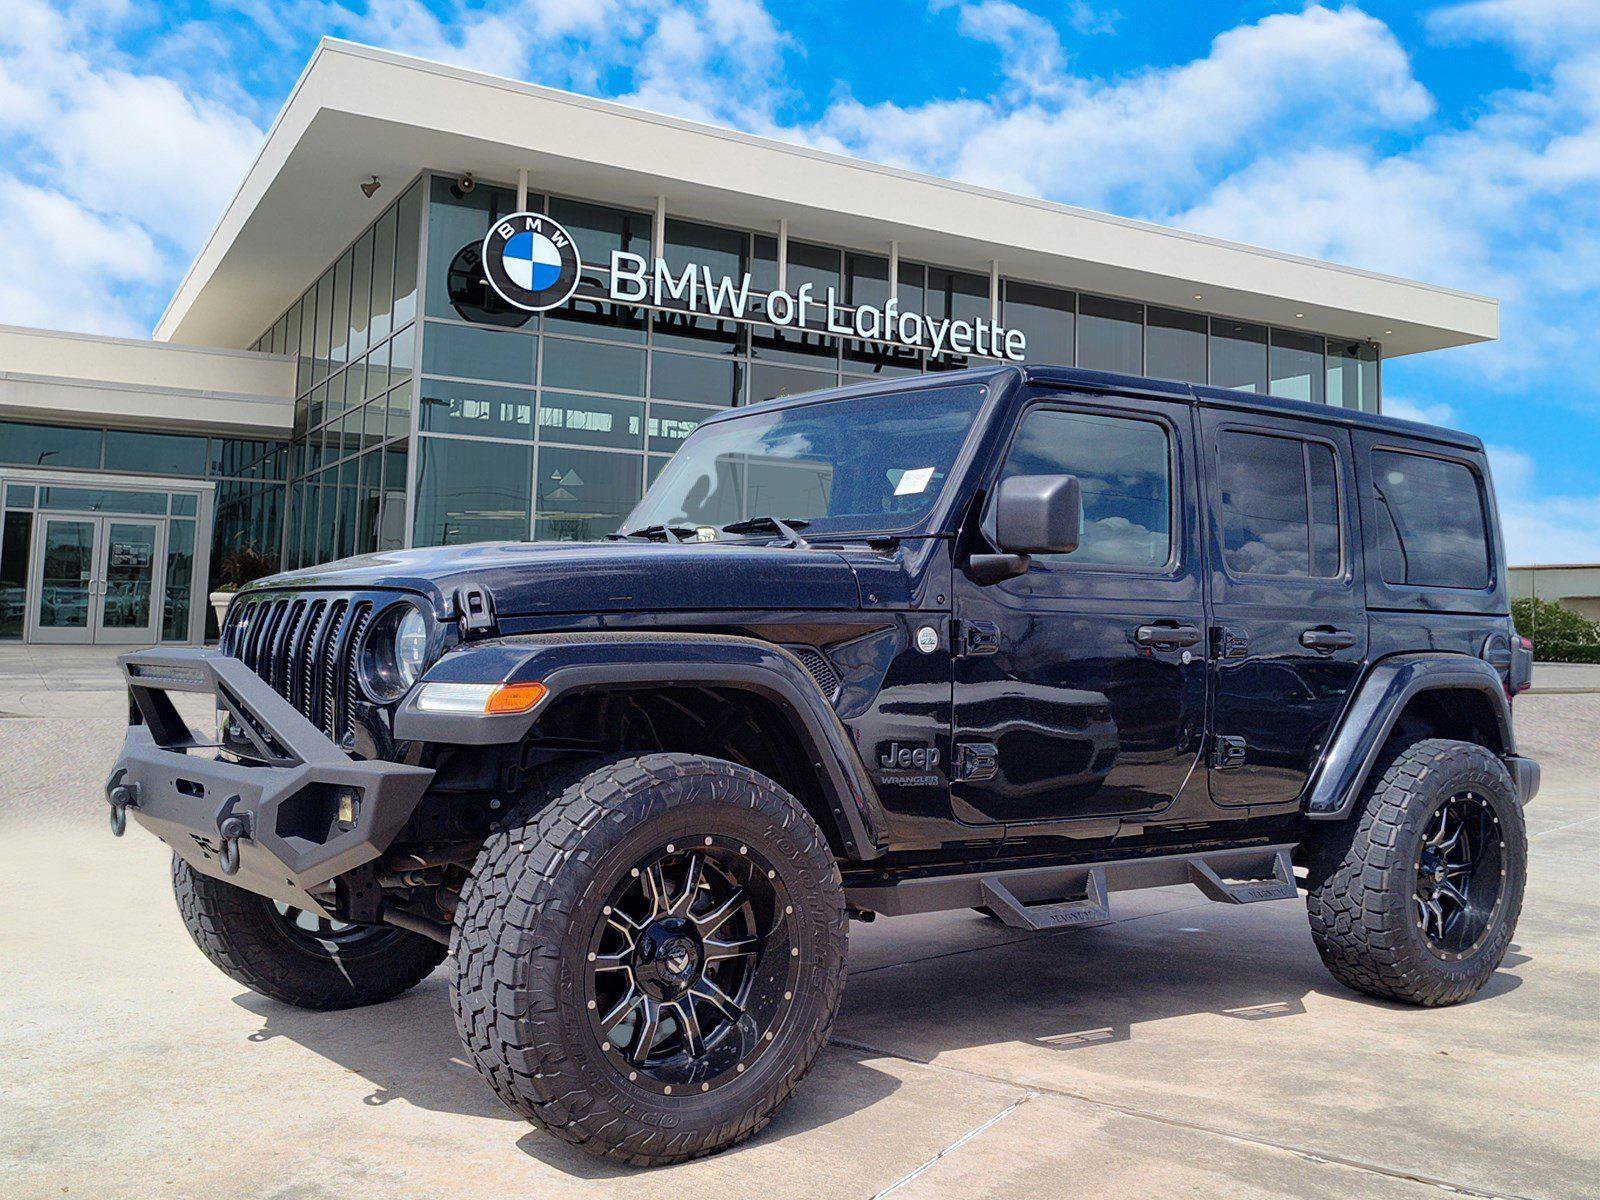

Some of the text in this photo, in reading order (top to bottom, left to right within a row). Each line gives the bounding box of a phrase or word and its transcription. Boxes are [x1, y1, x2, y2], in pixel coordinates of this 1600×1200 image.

[497, 217, 569, 249] BMW
[610, 250, 1026, 361] BMW of Lafayette
[881, 742, 941, 771] Jeep
[881, 776, 939, 784] WRANGLER
[608, 1090, 680, 1129] OPEN
